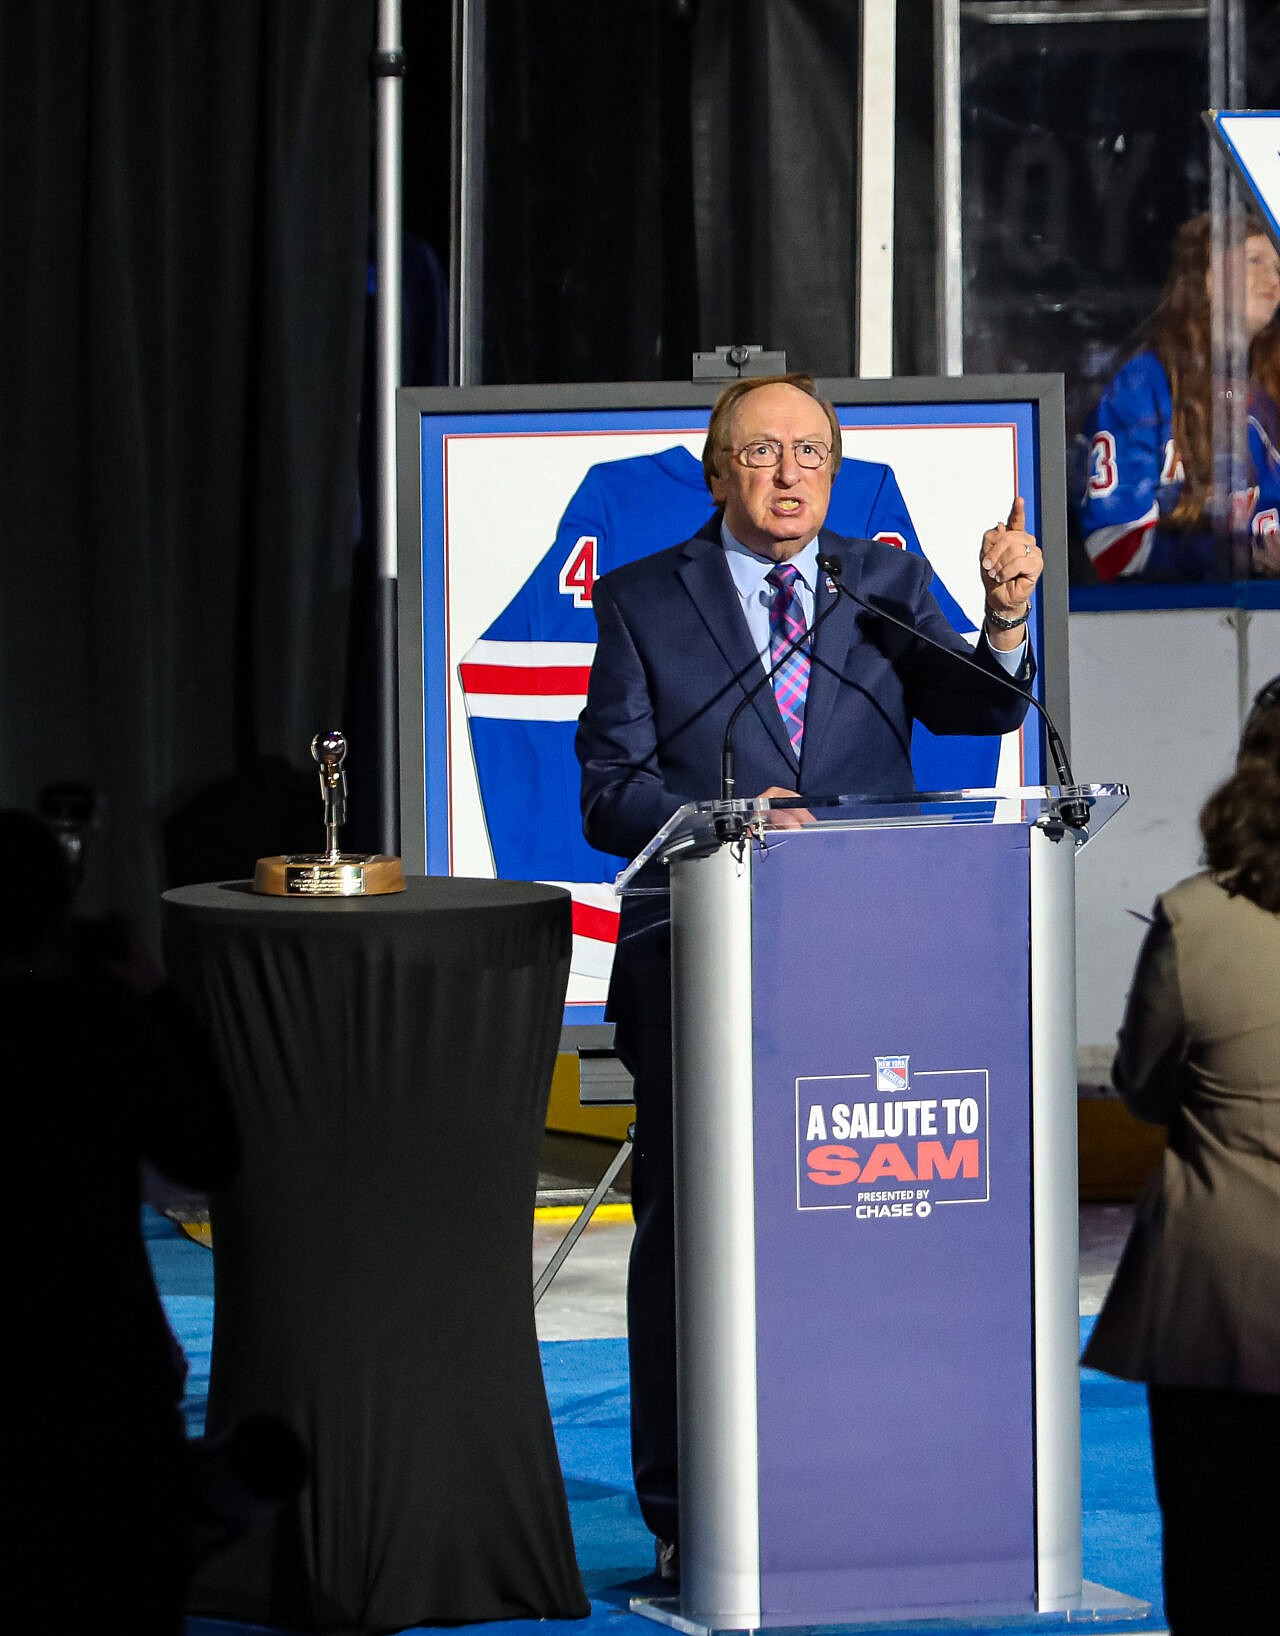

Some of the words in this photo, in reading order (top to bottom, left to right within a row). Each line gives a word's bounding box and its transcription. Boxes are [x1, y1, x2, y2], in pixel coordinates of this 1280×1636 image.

[559, 535, 600, 608] 4
[806, 1104, 827, 1141] A
[831, 1100, 938, 1140] SALUTE
[942, 1098, 979, 1135] TO
[806, 1139, 979, 1186] SAM
[855, 1203, 913, 1219] CHASE
[857, 1190, 914, 1202] PRESENTED
[916, 1189, 930, 1200] BY
